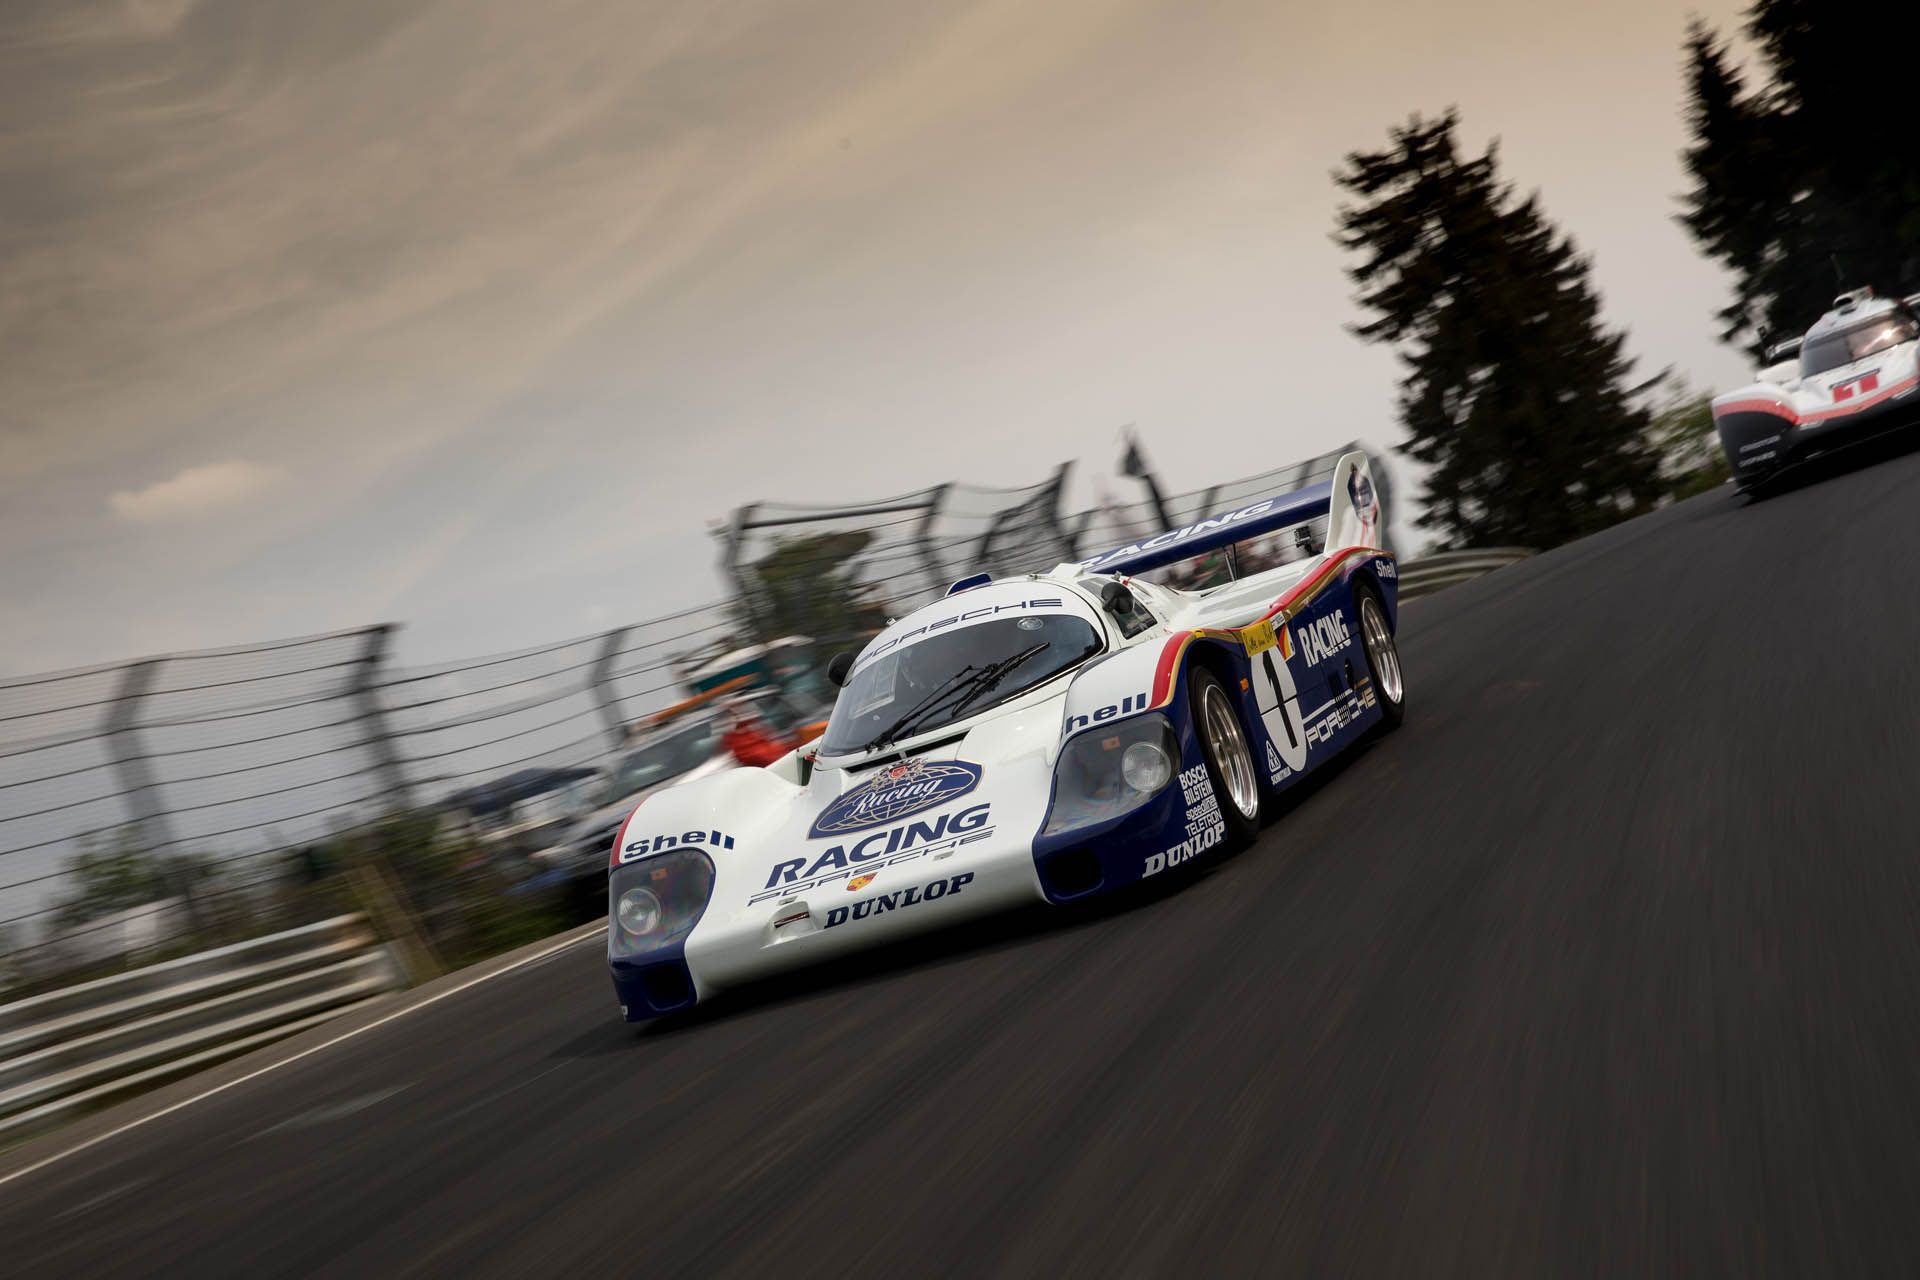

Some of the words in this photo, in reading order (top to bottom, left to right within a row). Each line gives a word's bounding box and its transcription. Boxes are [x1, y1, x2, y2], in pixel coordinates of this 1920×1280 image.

[1077, 500, 1274, 569] RACING
[852, 598, 1062, 675] PORSCHE
[1298, 609, 1351, 668] RACING
[1065, 692, 1146, 734] hell
[1262, 649, 1299, 749] 1
[1304, 686, 1376, 750] PORSCHE
[844, 778, 943, 819] Racing
[1179, 763, 1209, 791] BOSCH
[1184, 778, 1214, 806] BILSTEIN
[624, 830, 735, 859] Shell
[764, 802, 991, 889] RACING
[1142, 820, 1225, 878] DUNLOP
[1184, 808, 1223, 837] TELETRON
[747, 830, 994, 907] PORSCHE
[824, 871, 975, 929] DUNLOP
